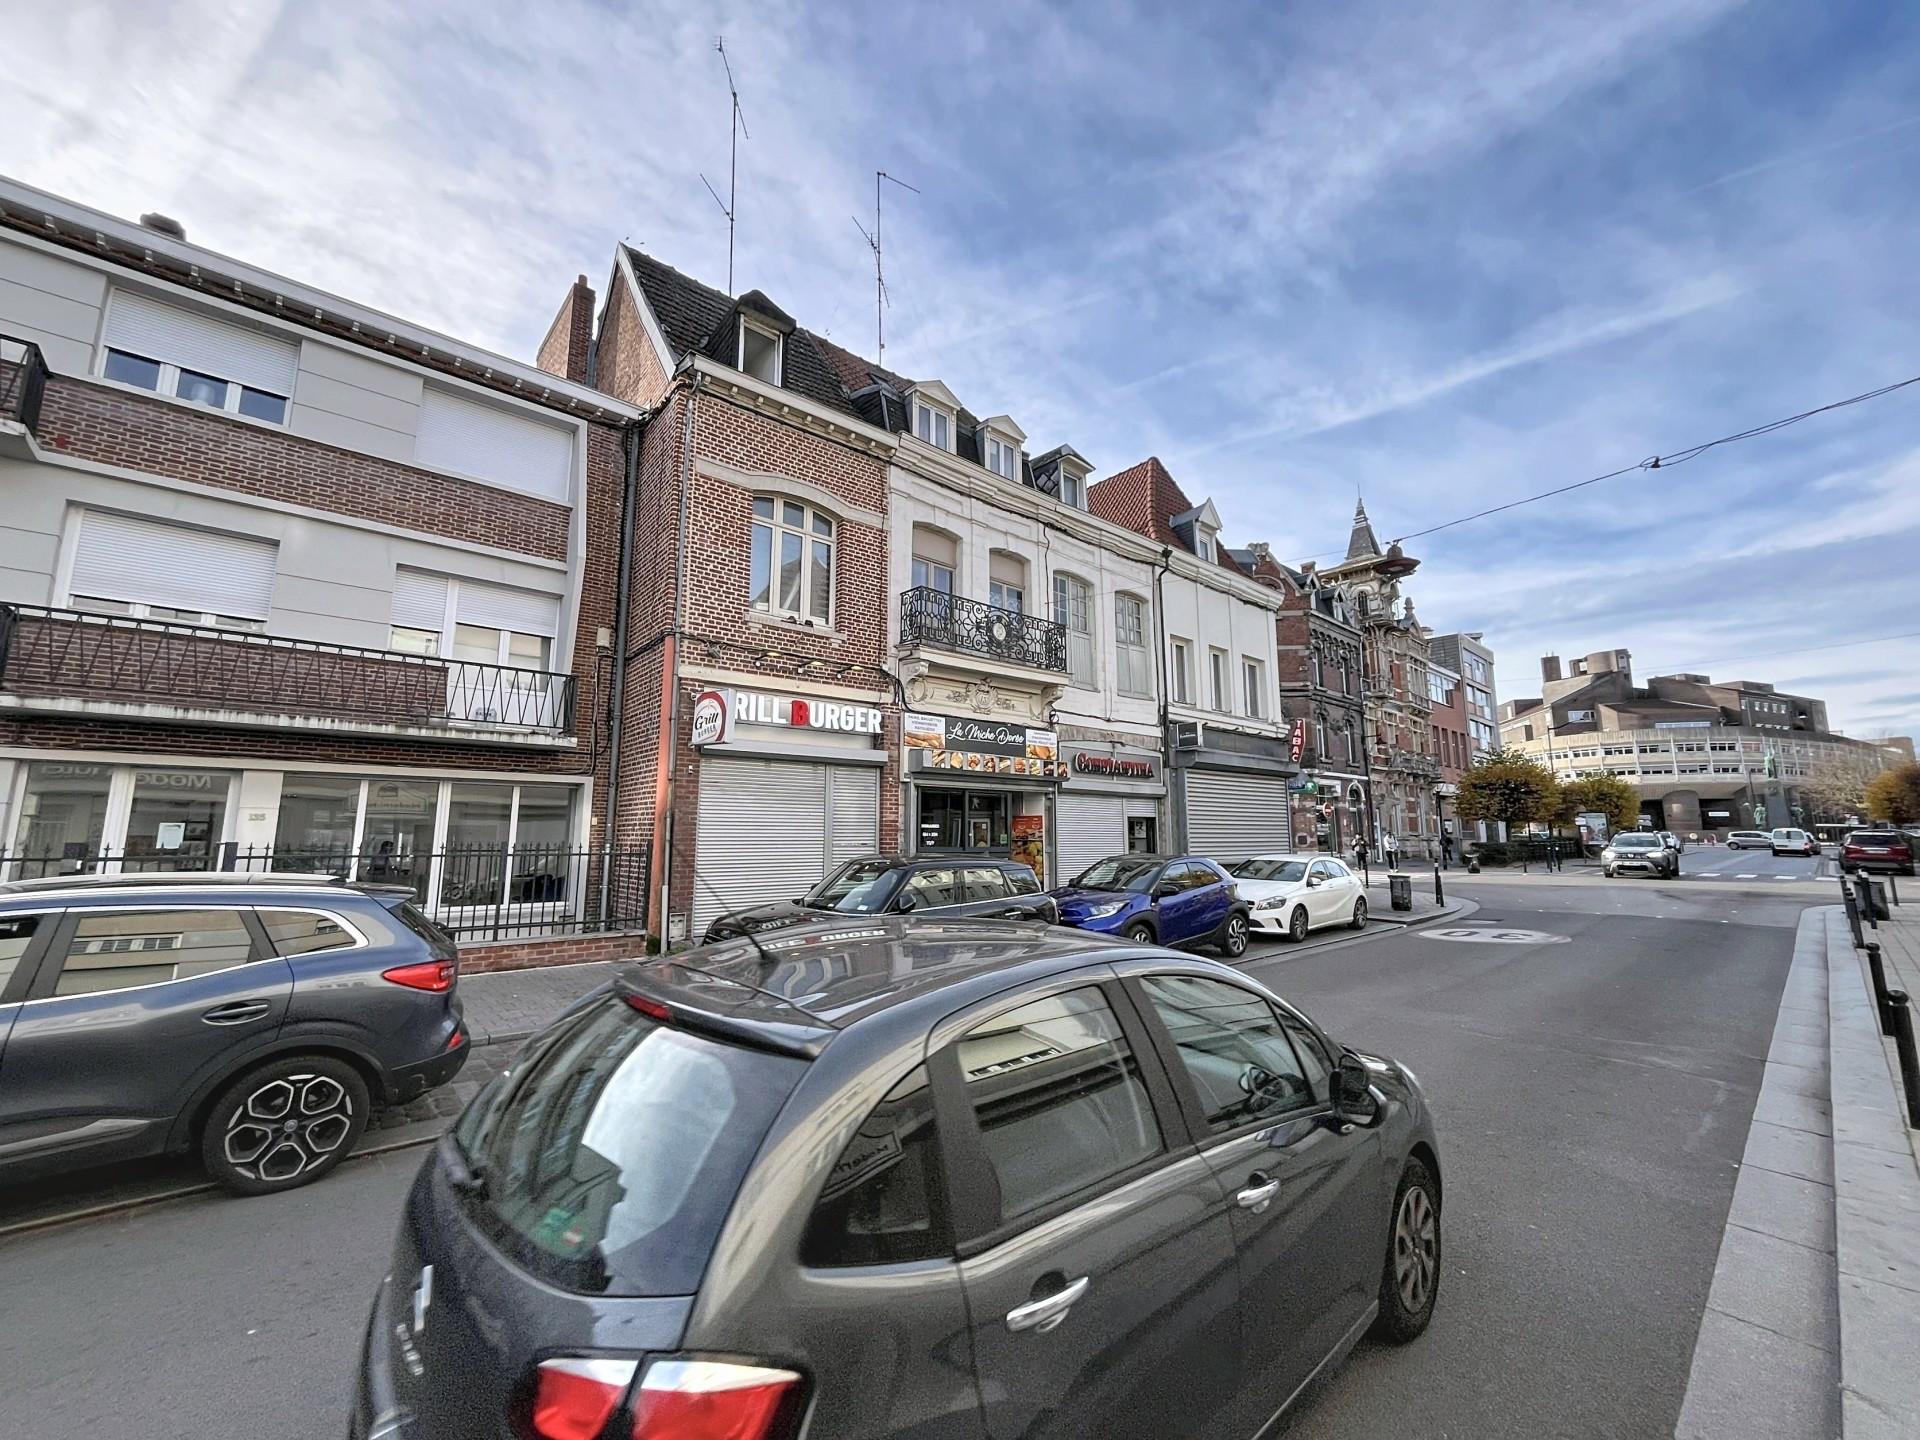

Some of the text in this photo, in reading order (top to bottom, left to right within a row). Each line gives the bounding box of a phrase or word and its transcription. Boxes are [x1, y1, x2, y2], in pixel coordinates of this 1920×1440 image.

[695, 712, 719, 730] Grill
[735, 692, 884, 734] RILL BURGER
[946, 722, 965, 741] La
[964, 723, 995, 740] Miche
[1291, 720, 1302, 762] TABAC
